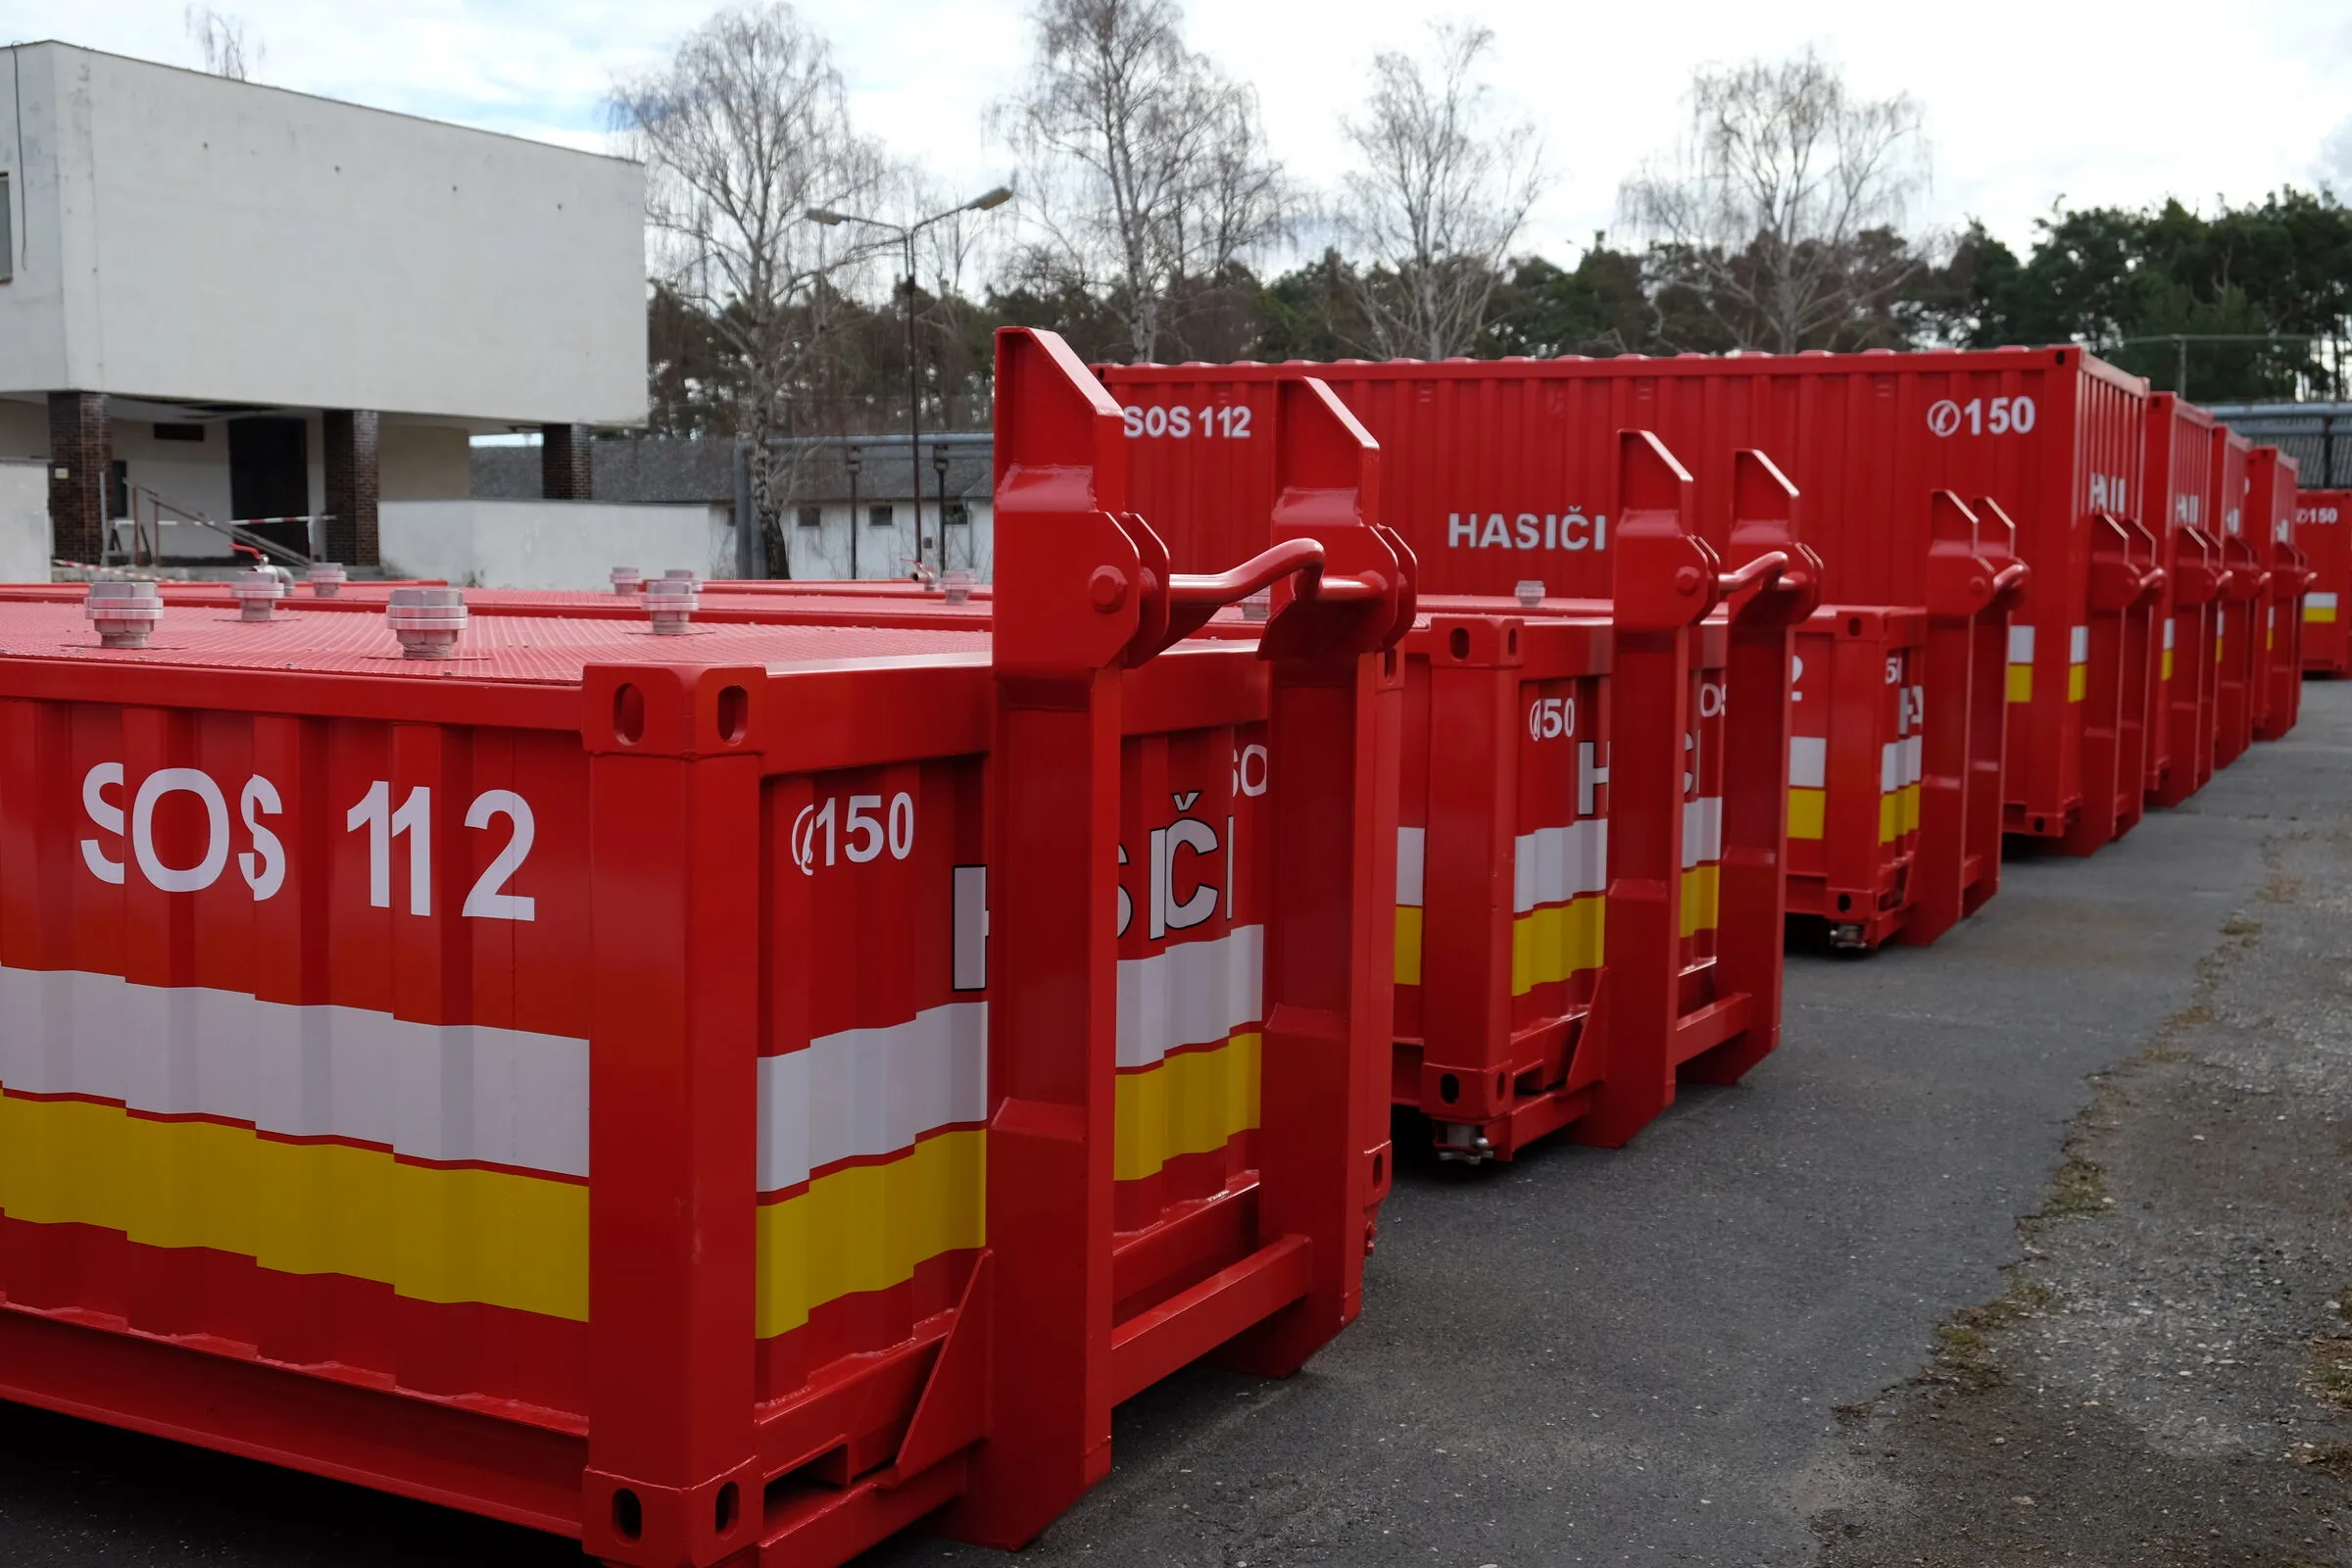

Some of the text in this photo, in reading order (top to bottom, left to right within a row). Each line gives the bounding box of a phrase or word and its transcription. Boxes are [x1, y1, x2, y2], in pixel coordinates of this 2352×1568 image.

[1123, 405, 1251, 438] SOS 112
[1964, 395, 2035, 436] 150
[1447, 505, 1606, 551] HASIČI
[2309, 507, 2338, 524] 150
[80, 761, 536, 921] SOS 112
[815, 791, 914, 866] 150
